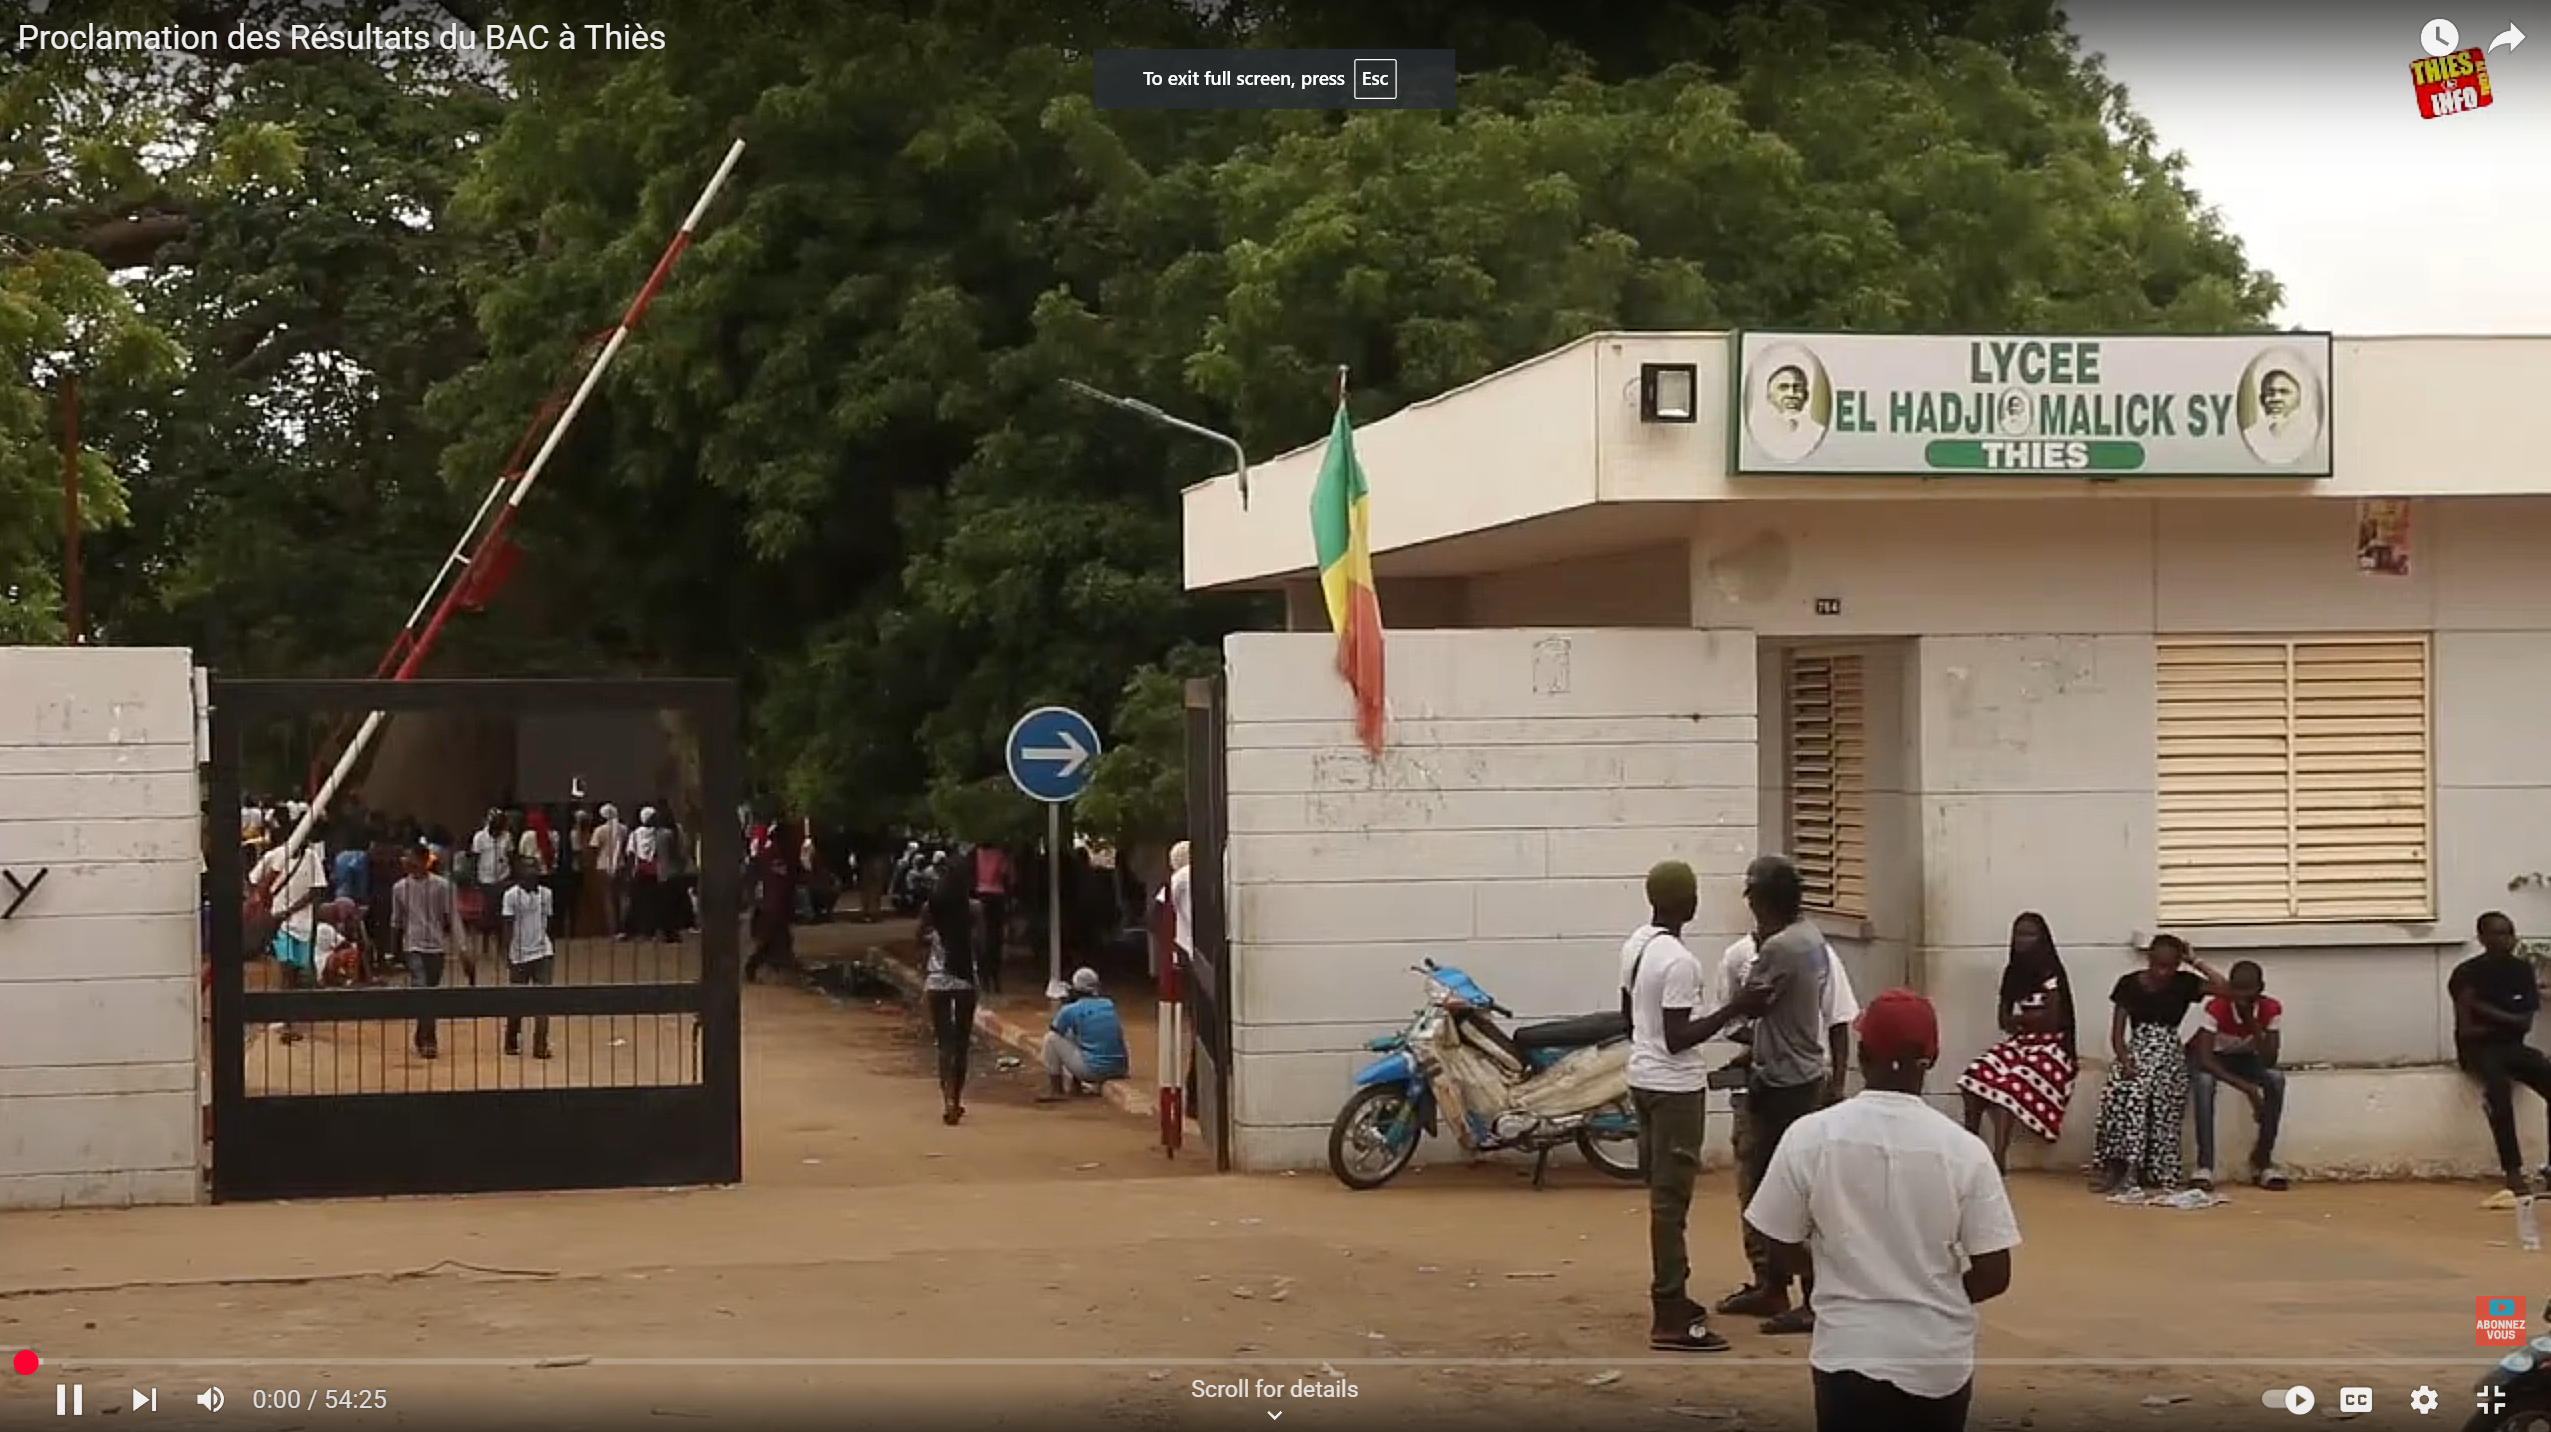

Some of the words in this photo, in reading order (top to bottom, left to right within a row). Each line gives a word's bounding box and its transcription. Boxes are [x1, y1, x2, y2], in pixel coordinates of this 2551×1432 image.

[1970, 341, 2100, 384] LYCEE
[1835, 390, 1877, 433] EL
[1889, 391, 1995, 435] HADJI
[2039, 393, 2175, 436] MALICK
[2187, 393, 2233, 436] SY
[1981, 441, 2090, 469] THIES
